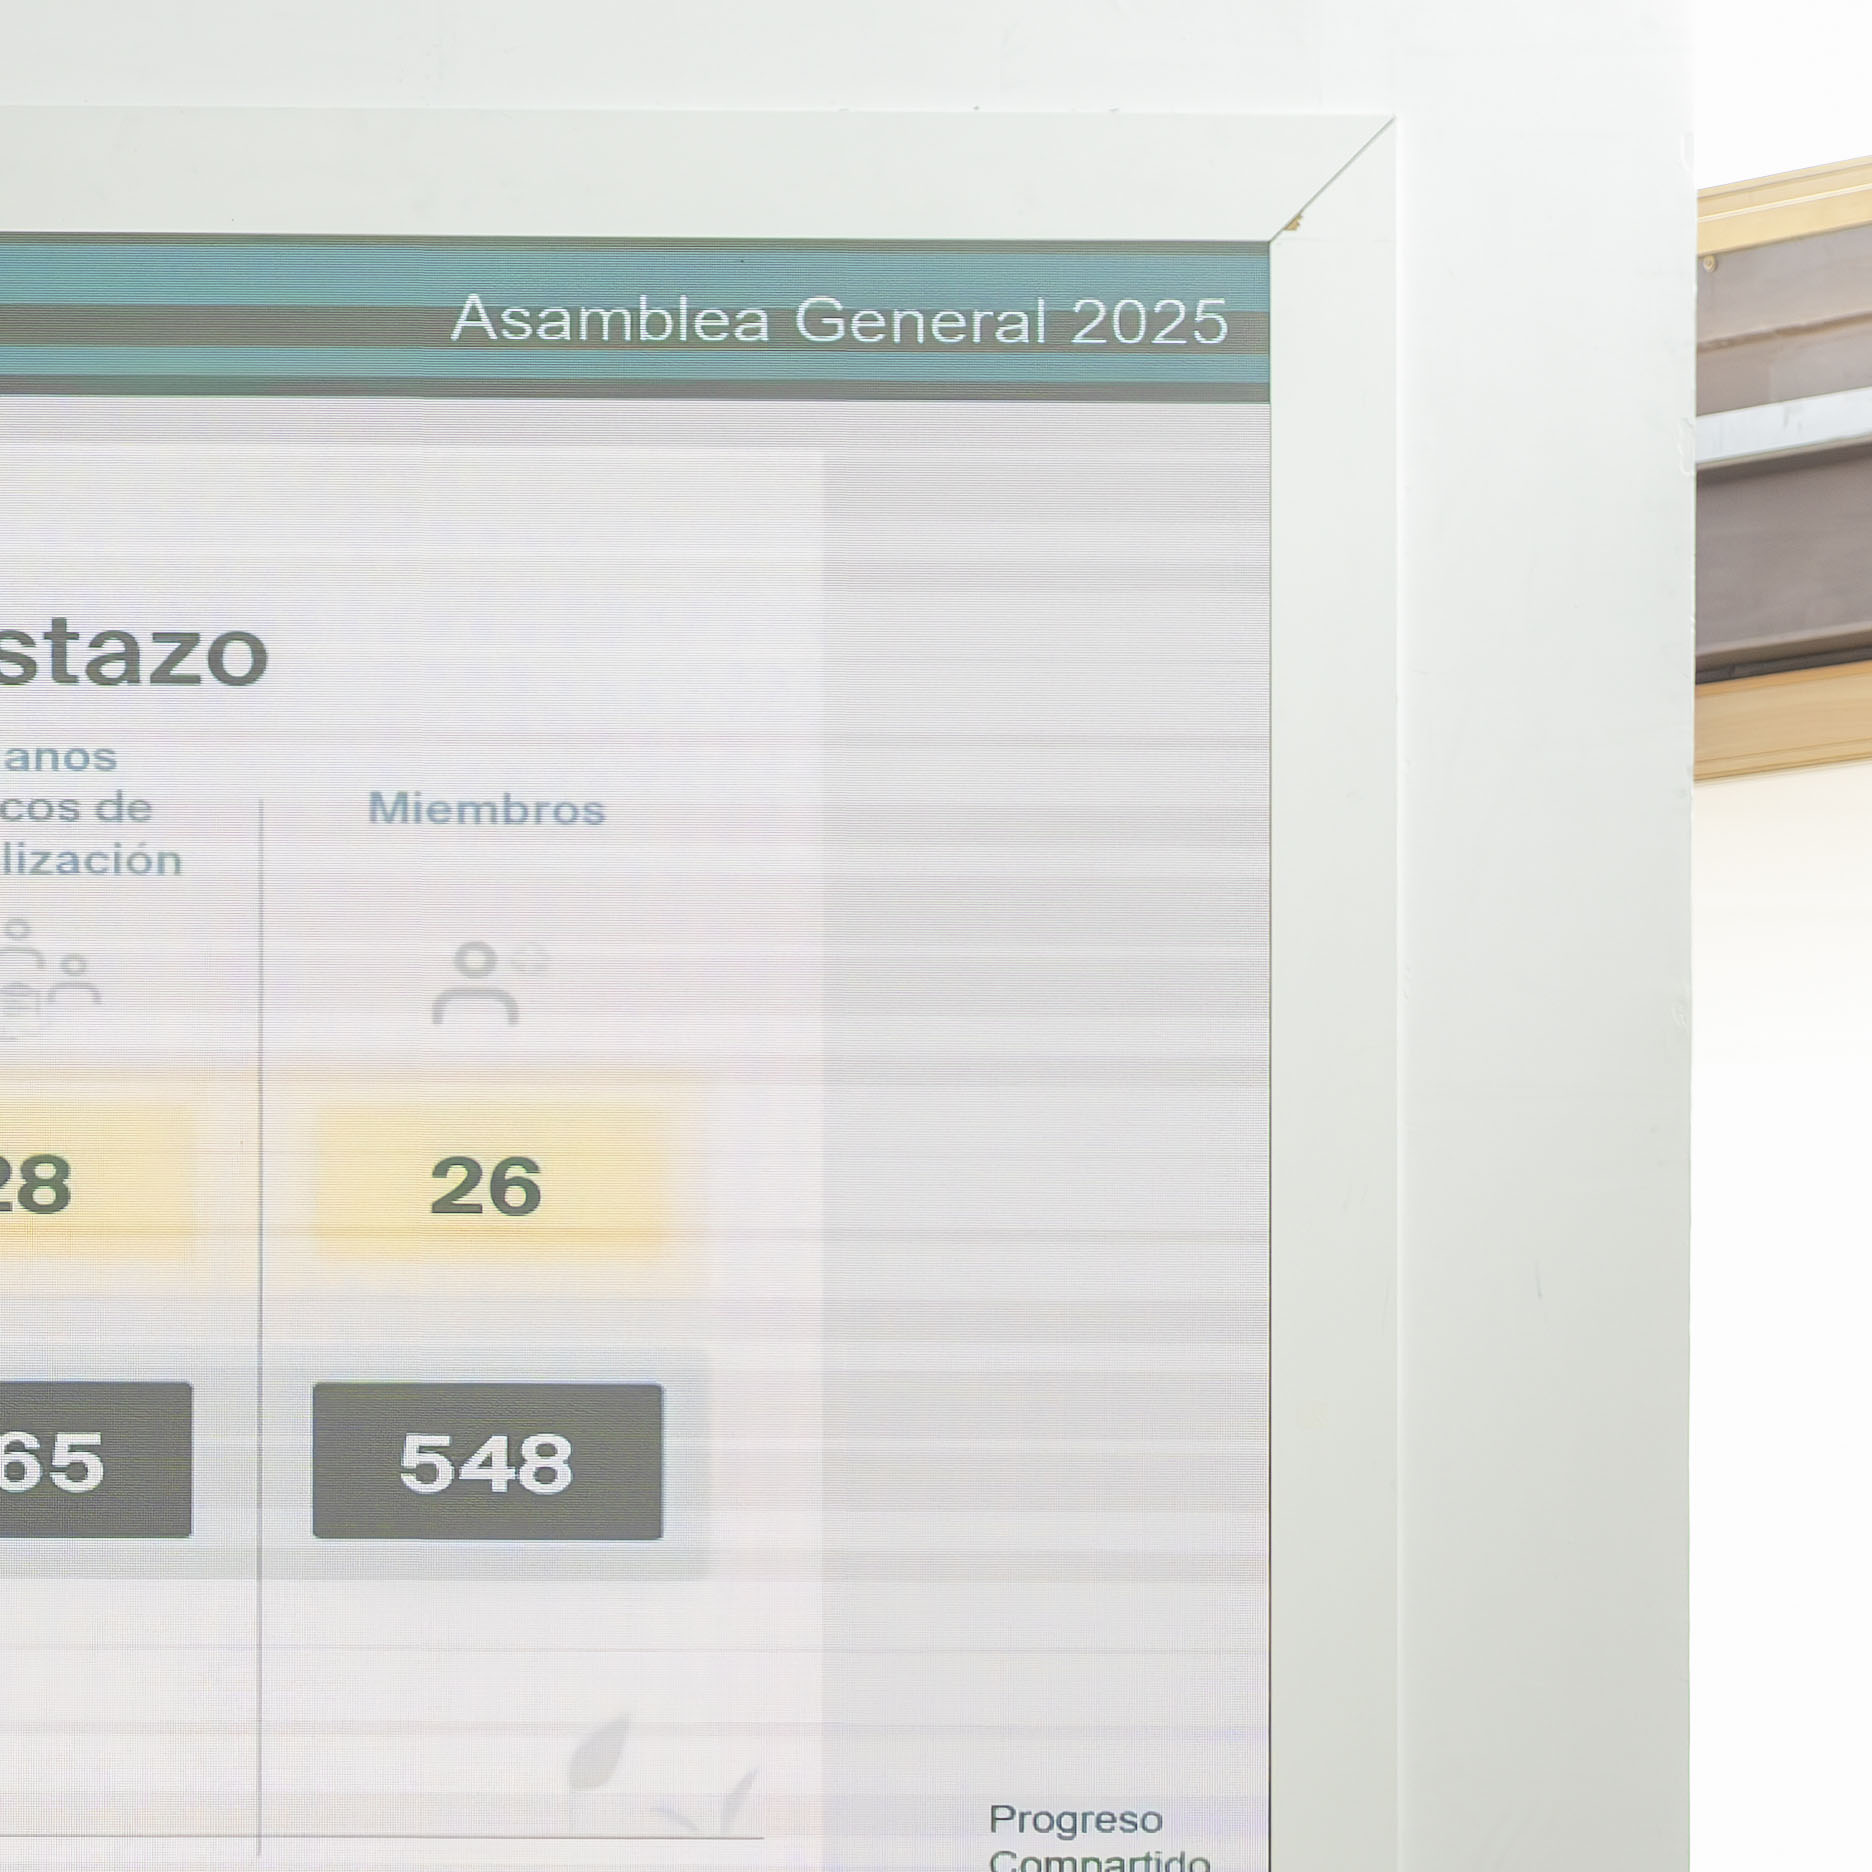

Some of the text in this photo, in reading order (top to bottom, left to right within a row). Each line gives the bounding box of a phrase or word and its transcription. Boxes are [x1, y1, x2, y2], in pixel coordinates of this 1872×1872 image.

[452, 293, 1227, 343] Asamblea General 2025
[95, 791, 152, 822] de
[370, 791, 605, 825] Miembros
[432, 1156, 540, 1216] 26
[402, 1434, 571, 1493] 548
[991, 1805, 1162, 1840] Progreso
